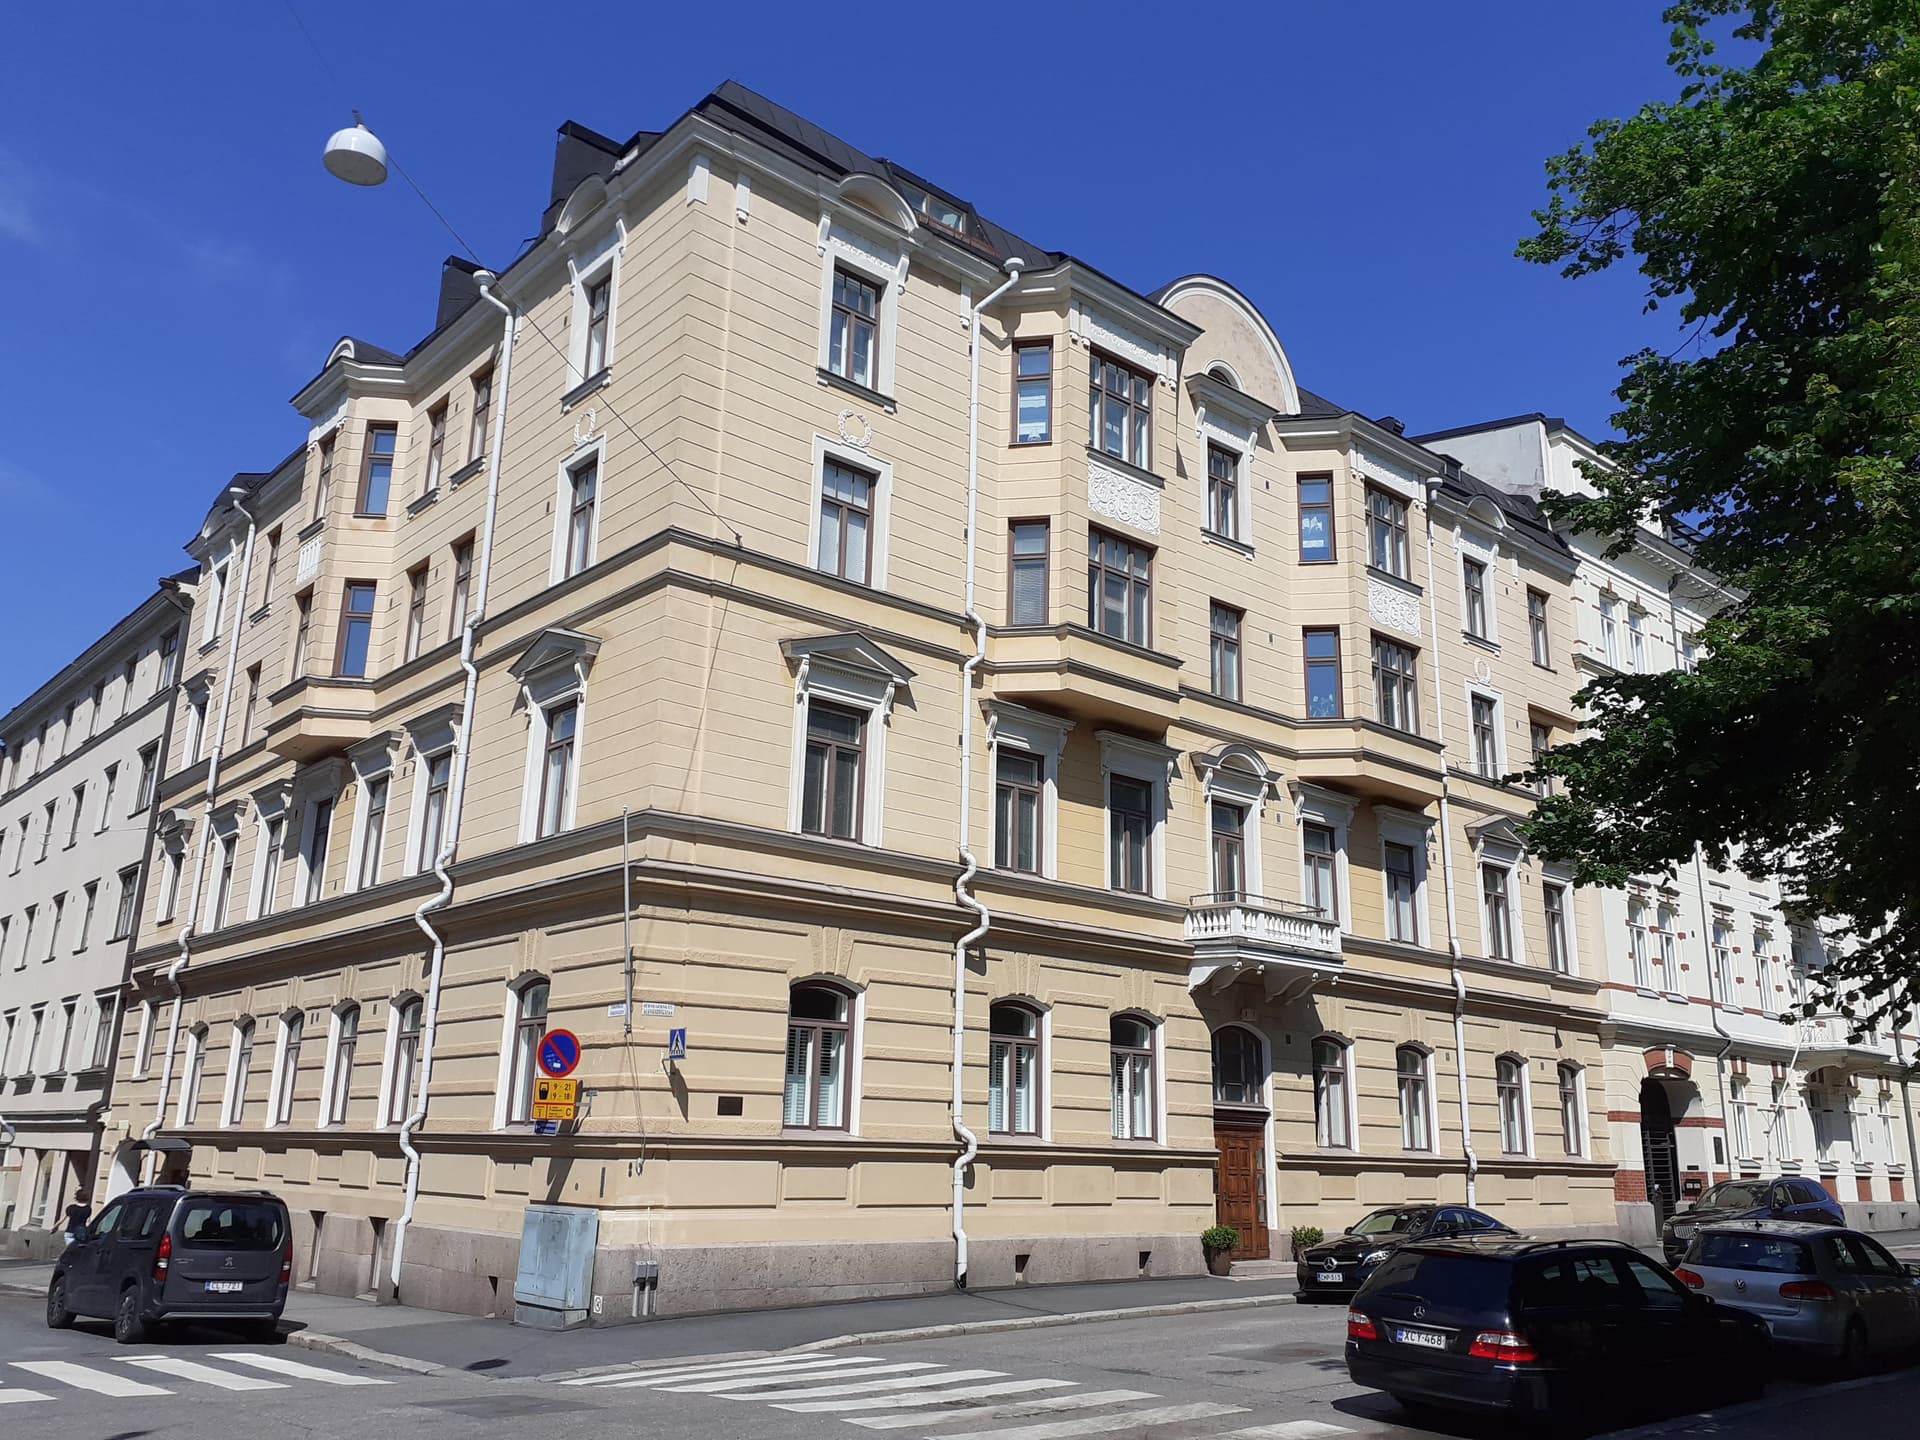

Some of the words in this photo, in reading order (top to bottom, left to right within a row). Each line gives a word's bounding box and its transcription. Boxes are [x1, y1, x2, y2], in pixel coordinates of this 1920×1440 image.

[564, 1083, 571, 1091] 21
[565, 1108, 572, 1117] C
[1404, 1330, 1442, 1345] XCY-468
